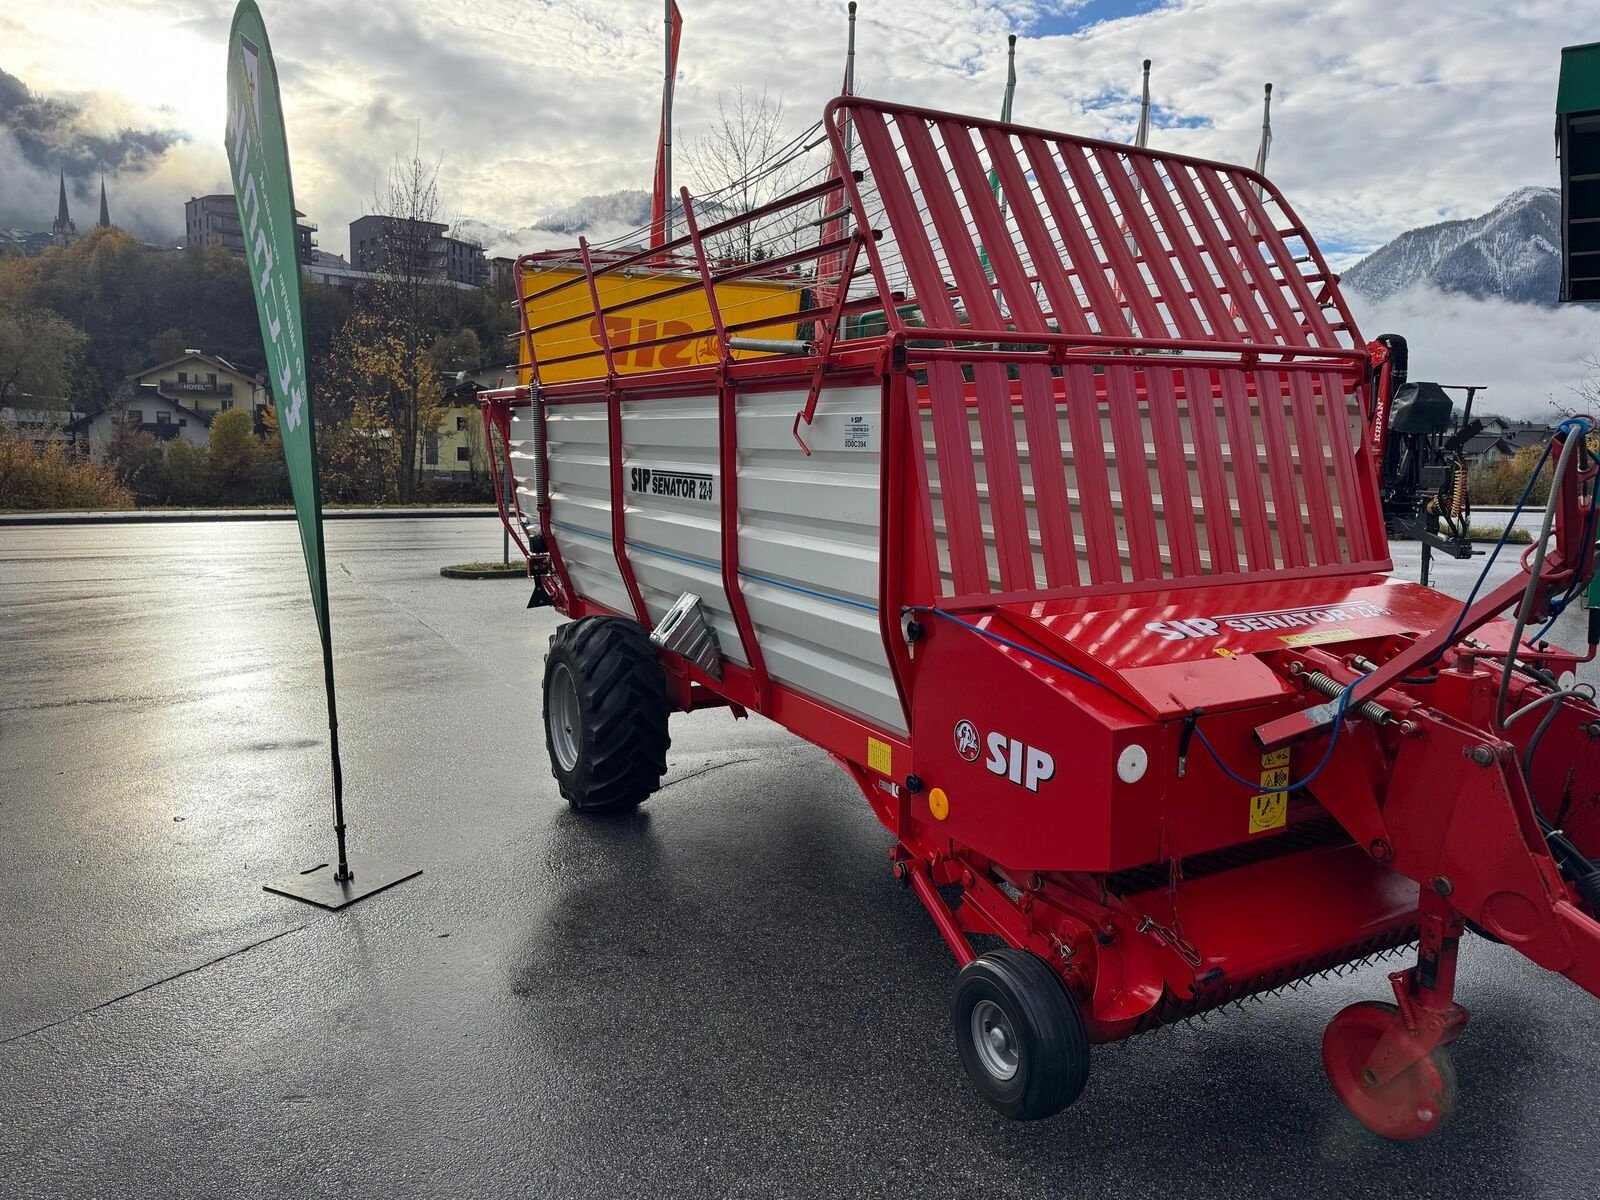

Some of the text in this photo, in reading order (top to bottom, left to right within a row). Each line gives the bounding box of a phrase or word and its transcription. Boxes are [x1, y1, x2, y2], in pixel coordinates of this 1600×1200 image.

[1374, 401, 1384, 442] KRPAN
[631, 467, 713, 501] SIP SENATOR 22-9
[1144, 617, 1220, 641] SIP
[1225, 608, 1355, 633] SENATOR
[986, 731, 1056, 794] SIP
